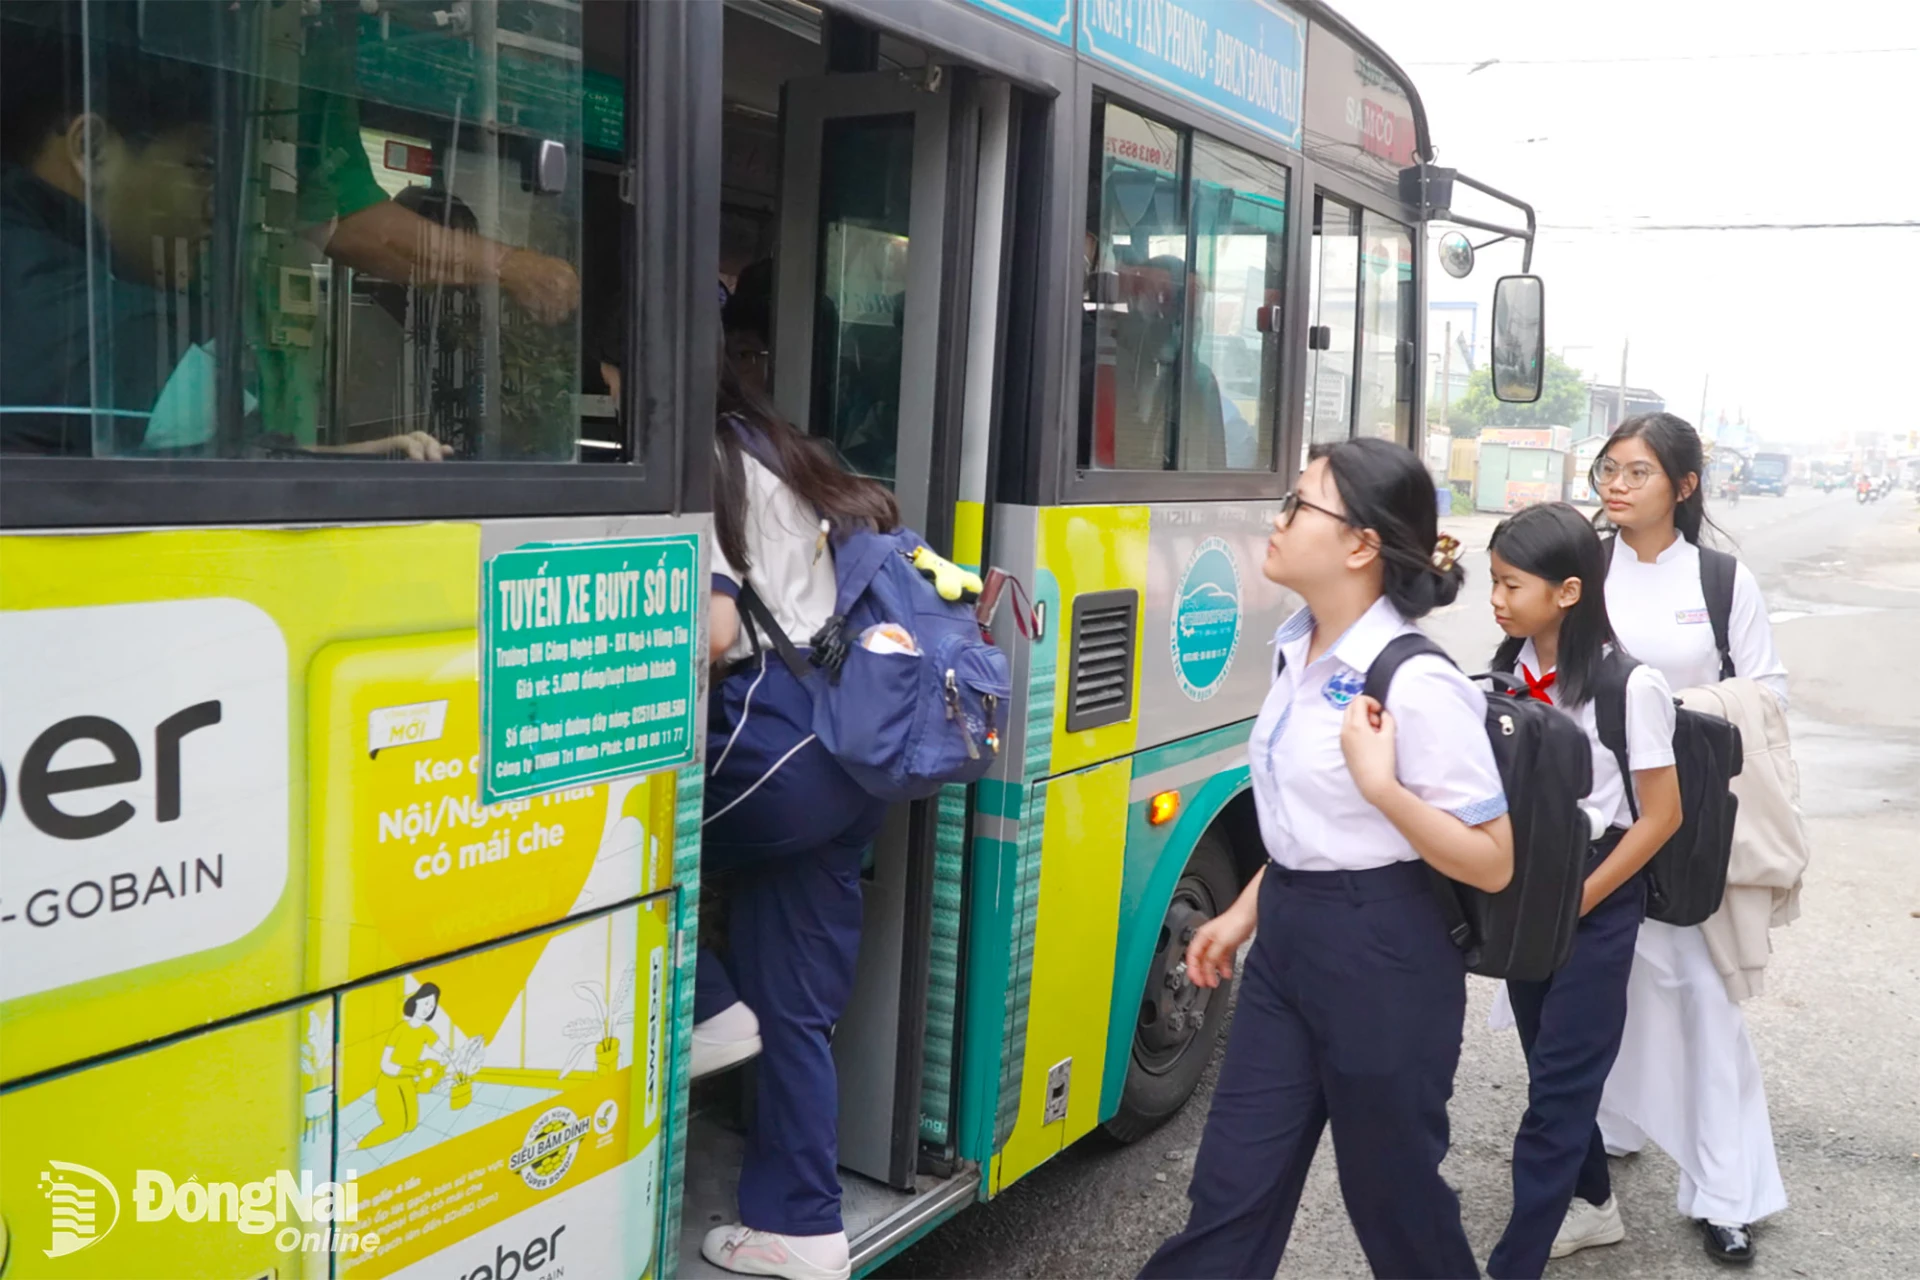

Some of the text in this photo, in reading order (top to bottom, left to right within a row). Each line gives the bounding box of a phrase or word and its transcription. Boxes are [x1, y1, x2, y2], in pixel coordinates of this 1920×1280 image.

[1126, 0, 1132, 44] 4
[1164, 2, 1208, 79] PHONG
[1278, 64, 1297, 122] NAI
[498, 552, 688, 631] TUYẾN XE BUÝT SỐ 01
[552, 672, 580, 694] 5.000
[662, 730, 671, 744] 11
[673, 727, 684, 741] 77
[0, 699, 221, 840] er
[414, 757, 463, 785] Keo
[413, 822, 565, 880] có mái che
[564, 1117, 591, 1142] DÍNH
[459, 1224, 566, 1280] ber
